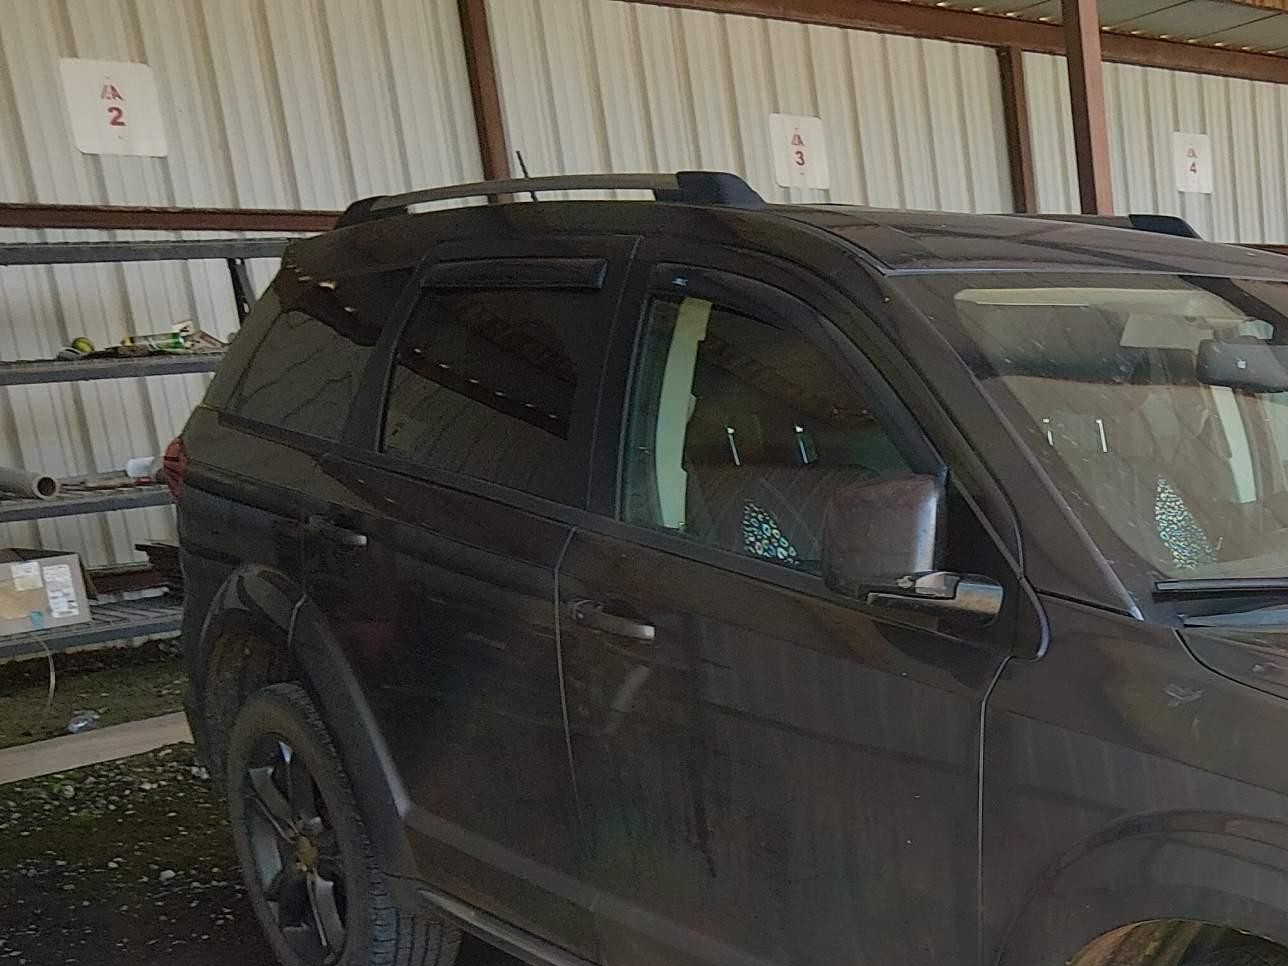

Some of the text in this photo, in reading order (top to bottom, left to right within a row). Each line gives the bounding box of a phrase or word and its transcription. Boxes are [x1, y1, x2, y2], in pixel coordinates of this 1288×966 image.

[108, 106, 126, 127] 2
[795, 150, 806, 167] 3
[1189, 160, 1198, 175] 4
